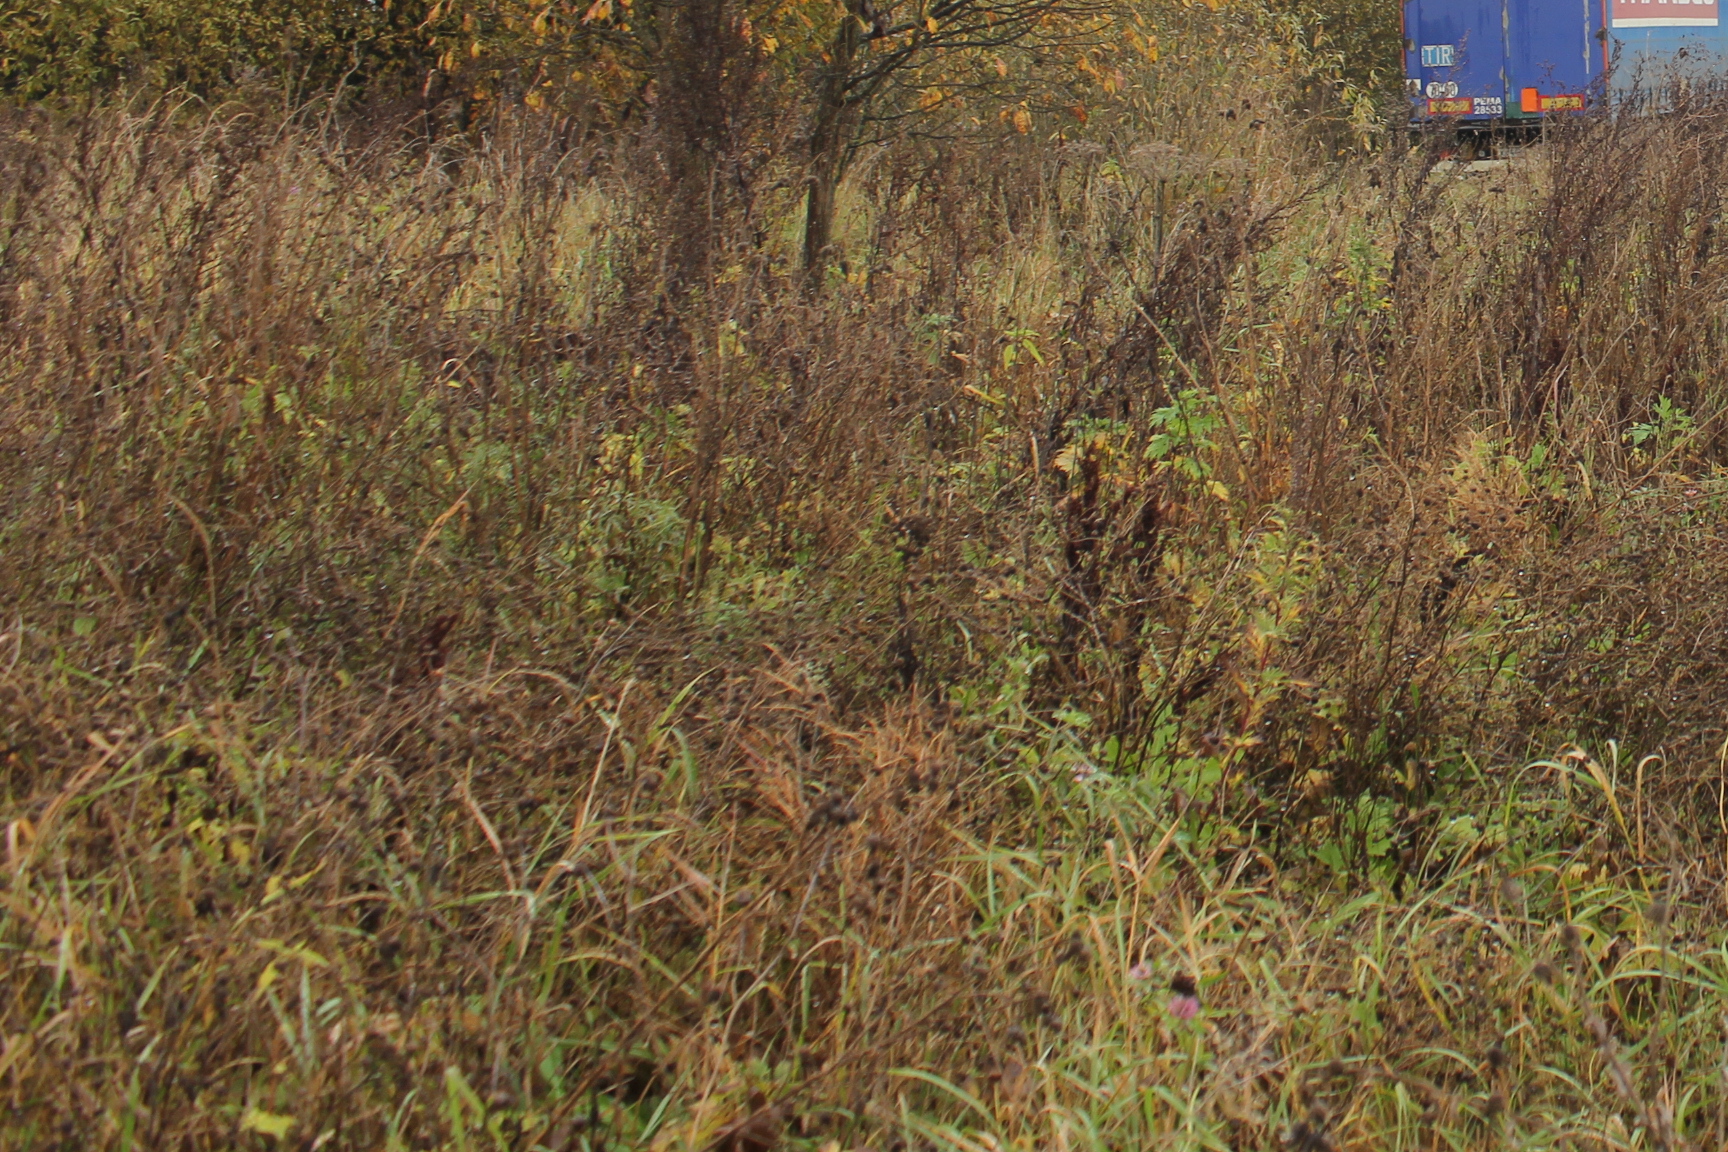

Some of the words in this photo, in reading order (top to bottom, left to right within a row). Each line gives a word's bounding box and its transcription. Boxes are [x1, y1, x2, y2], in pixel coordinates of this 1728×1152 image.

[1425, 47, 1452, 64] TIR
[1474, 97, 1502, 106] PEMA
[1474, 105, 1502, 115] 28533
